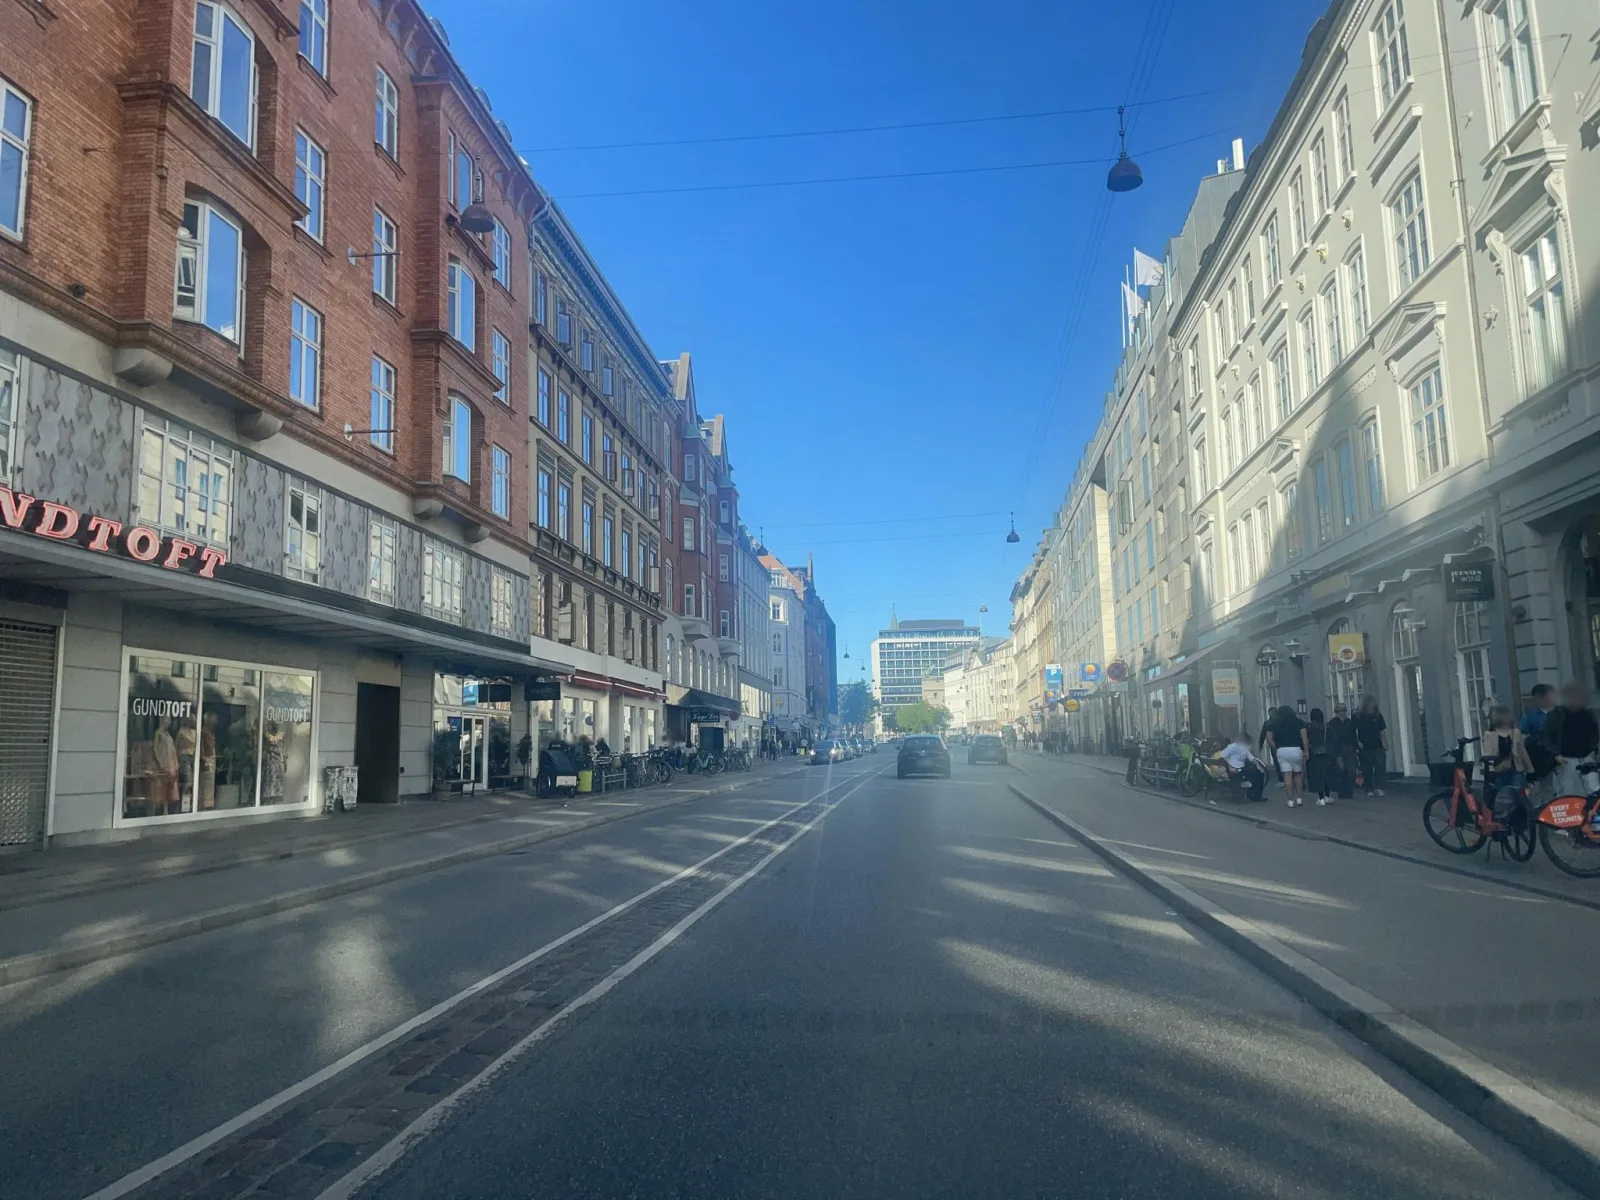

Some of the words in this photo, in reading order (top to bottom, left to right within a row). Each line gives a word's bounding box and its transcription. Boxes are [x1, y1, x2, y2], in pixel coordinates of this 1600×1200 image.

[133, 698, 192, 718] GUNDTOFT
[266, 705, 308, 723] GUNDTOFT
[1554, 815, 1582, 823] COUNTS
